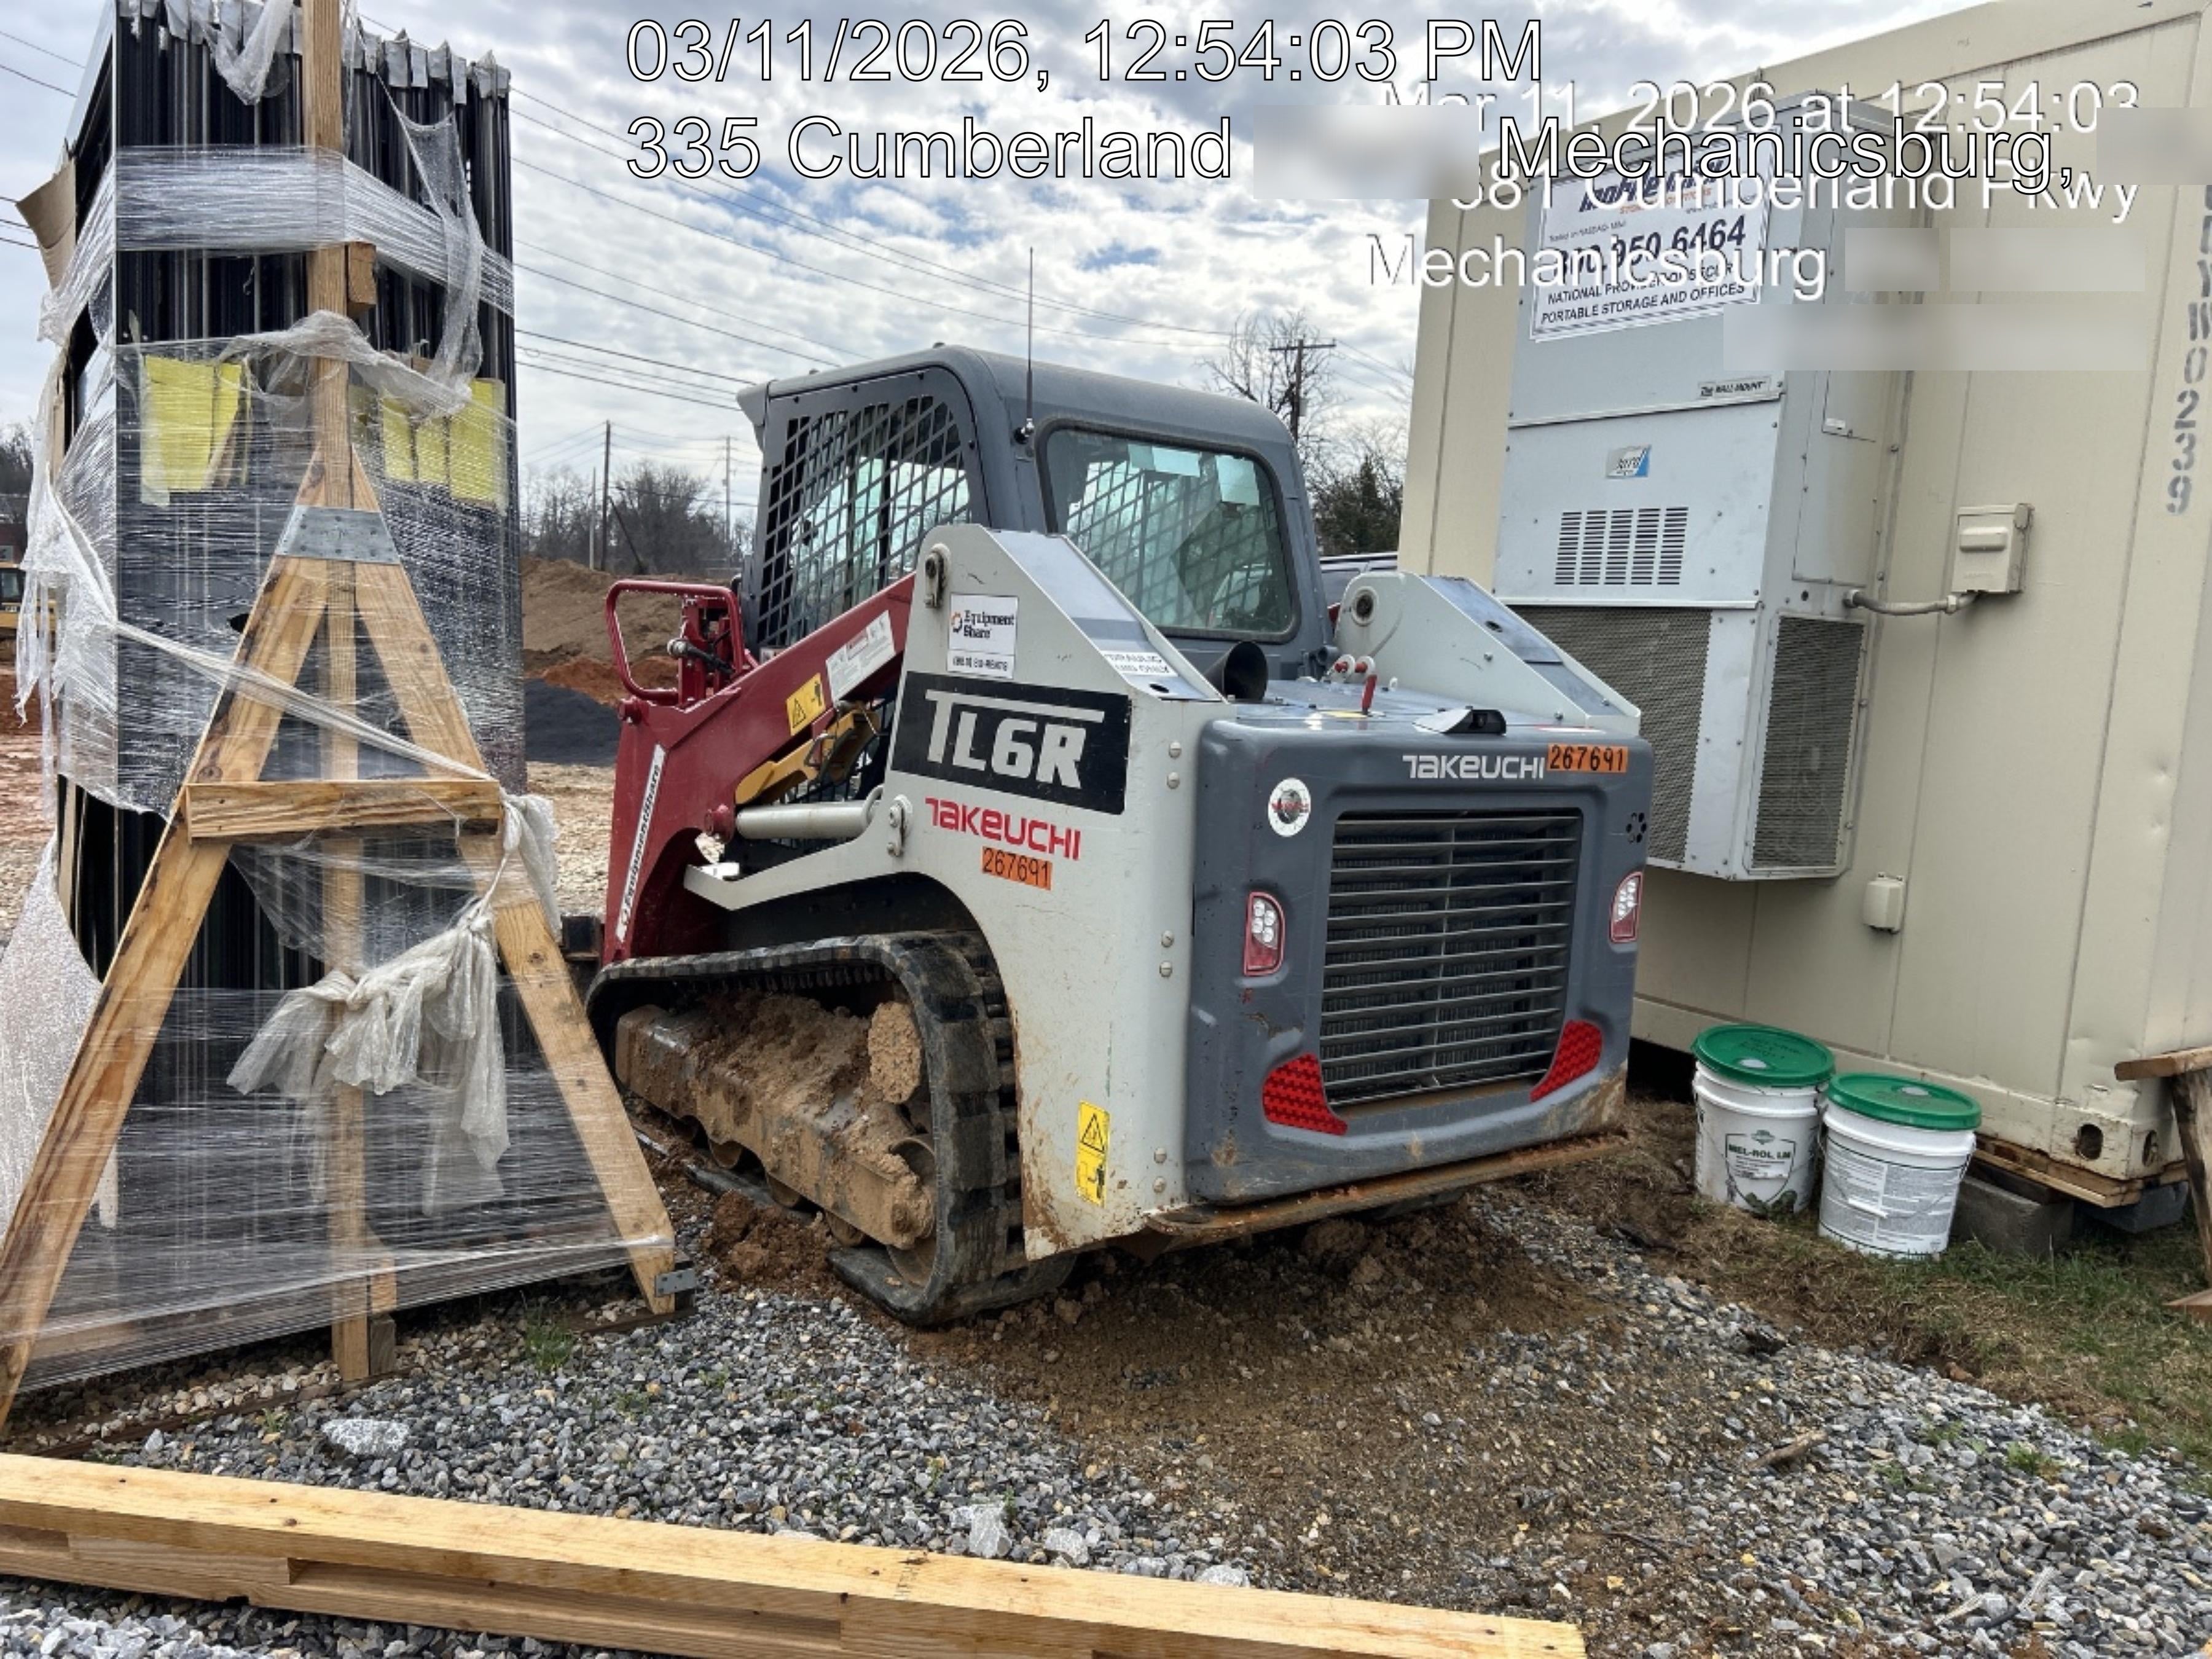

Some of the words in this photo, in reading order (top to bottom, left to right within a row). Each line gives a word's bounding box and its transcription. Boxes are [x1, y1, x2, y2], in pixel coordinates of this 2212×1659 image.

[1671, 213, 1746, 259] 6464
[1540, 304, 1599, 325] PORTABLE
[1601, 294, 1658, 316] STORAGE
[1660, 289, 1687, 306] AND
[1690, 283, 1745, 300] OFFICES
[1547, 284, 1602, 305] NATIONAL
[925, 689, 1105, 790] TL6R
[1550, 744, 1623, 771] 267691
[982, 847, 1049, 887] 267691
